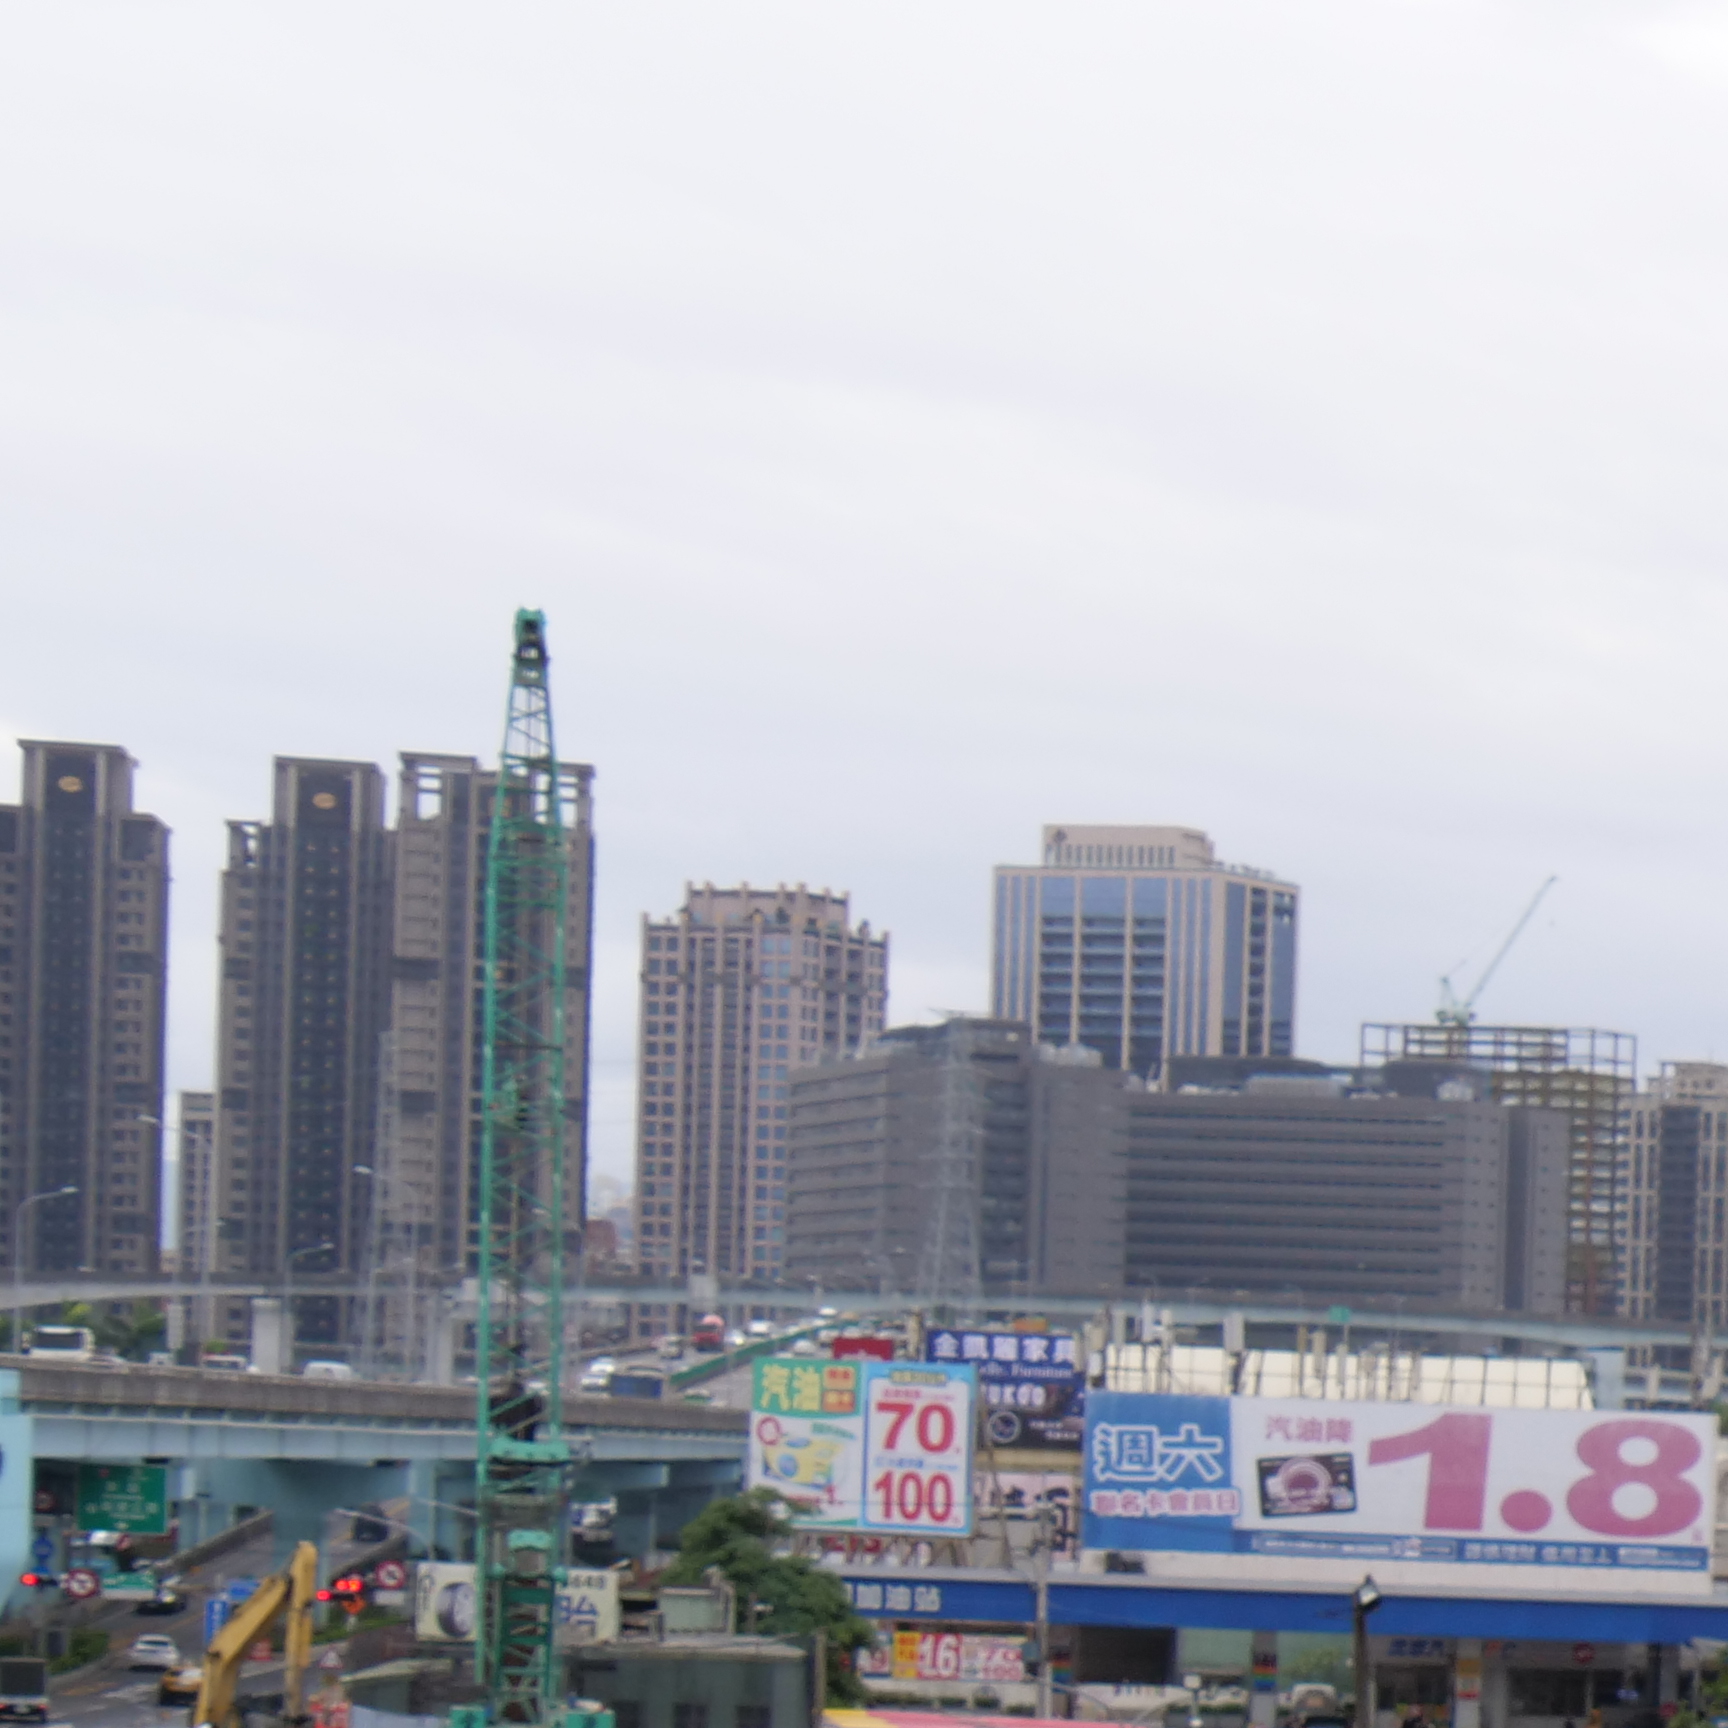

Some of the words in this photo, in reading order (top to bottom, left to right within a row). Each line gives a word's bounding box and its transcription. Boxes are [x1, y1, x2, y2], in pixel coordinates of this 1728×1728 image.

[761, 1363, 822, 1412] 汽油
[875, 1402, 955, 1453] 70
[1093, 1422, 1224, 1483] 週六
[1265, 1414, 1355, 1444] 汽油降
[874, 1470, 953, 1522] 100
[1368, 1412, 1703, 1537] 1.8
